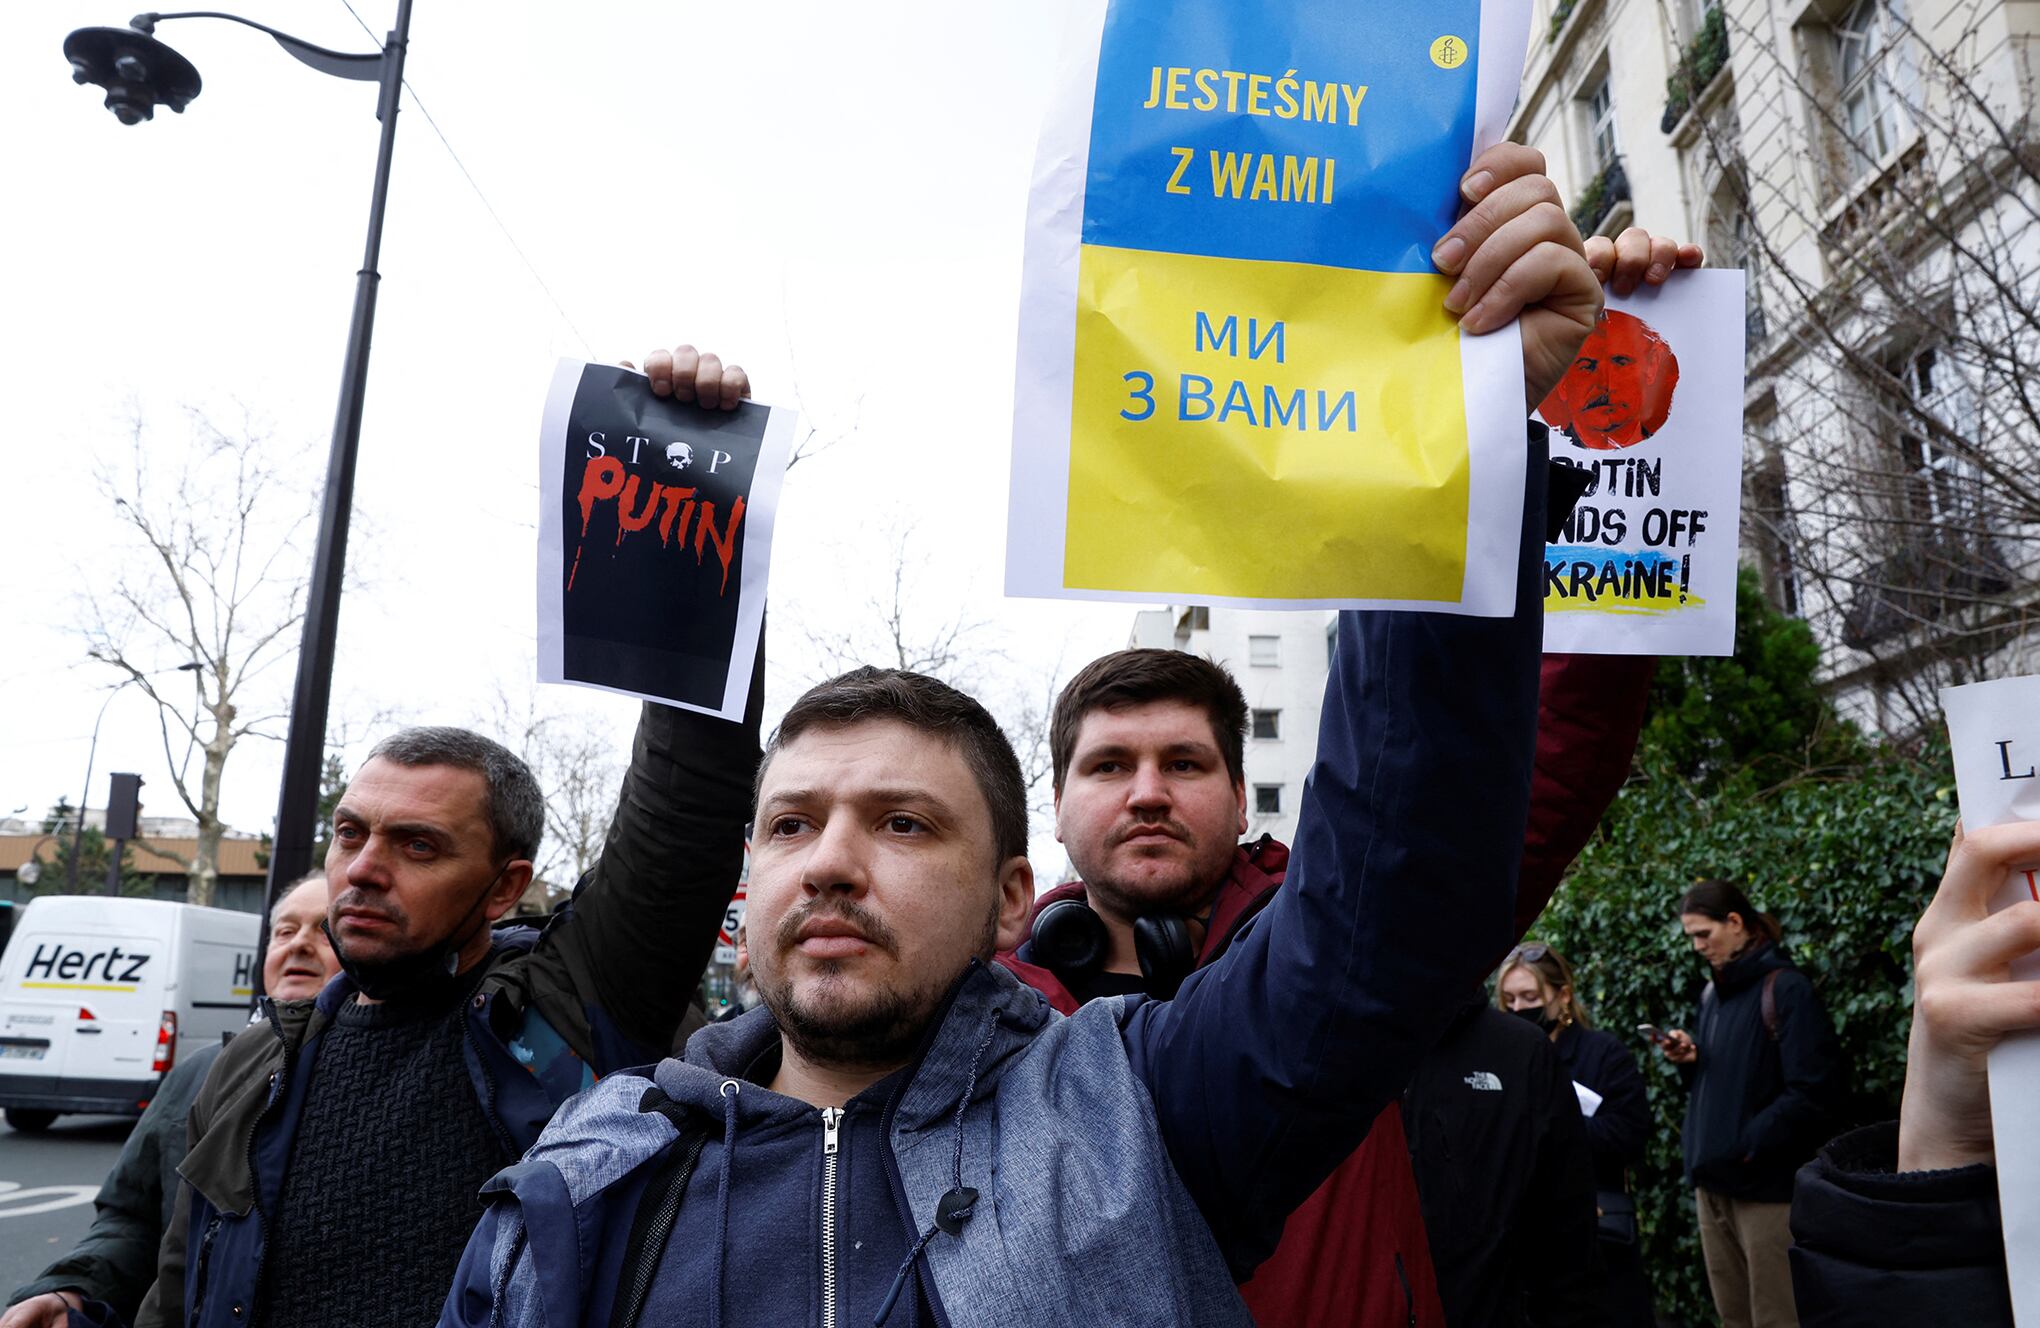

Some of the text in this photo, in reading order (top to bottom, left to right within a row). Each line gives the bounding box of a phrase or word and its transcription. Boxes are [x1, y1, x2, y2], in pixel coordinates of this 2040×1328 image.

[1143, 67, 1368, 126] JESTEŚMY
[1166, 147, 1335, 204] Z WAMI
[1195, 311, 1285, 364] МИ
[1119, 370, 1357, 433] З ВАМИ
[1550, 456, 1662, 498] UTiN
[570, 455, 746, 590] PUTIN
[1557, 505, 1709, 548] NDS OFF
[1544, 553, 1691, 605] KRAiNE!
[25, 944, 150, 982] Hertz
